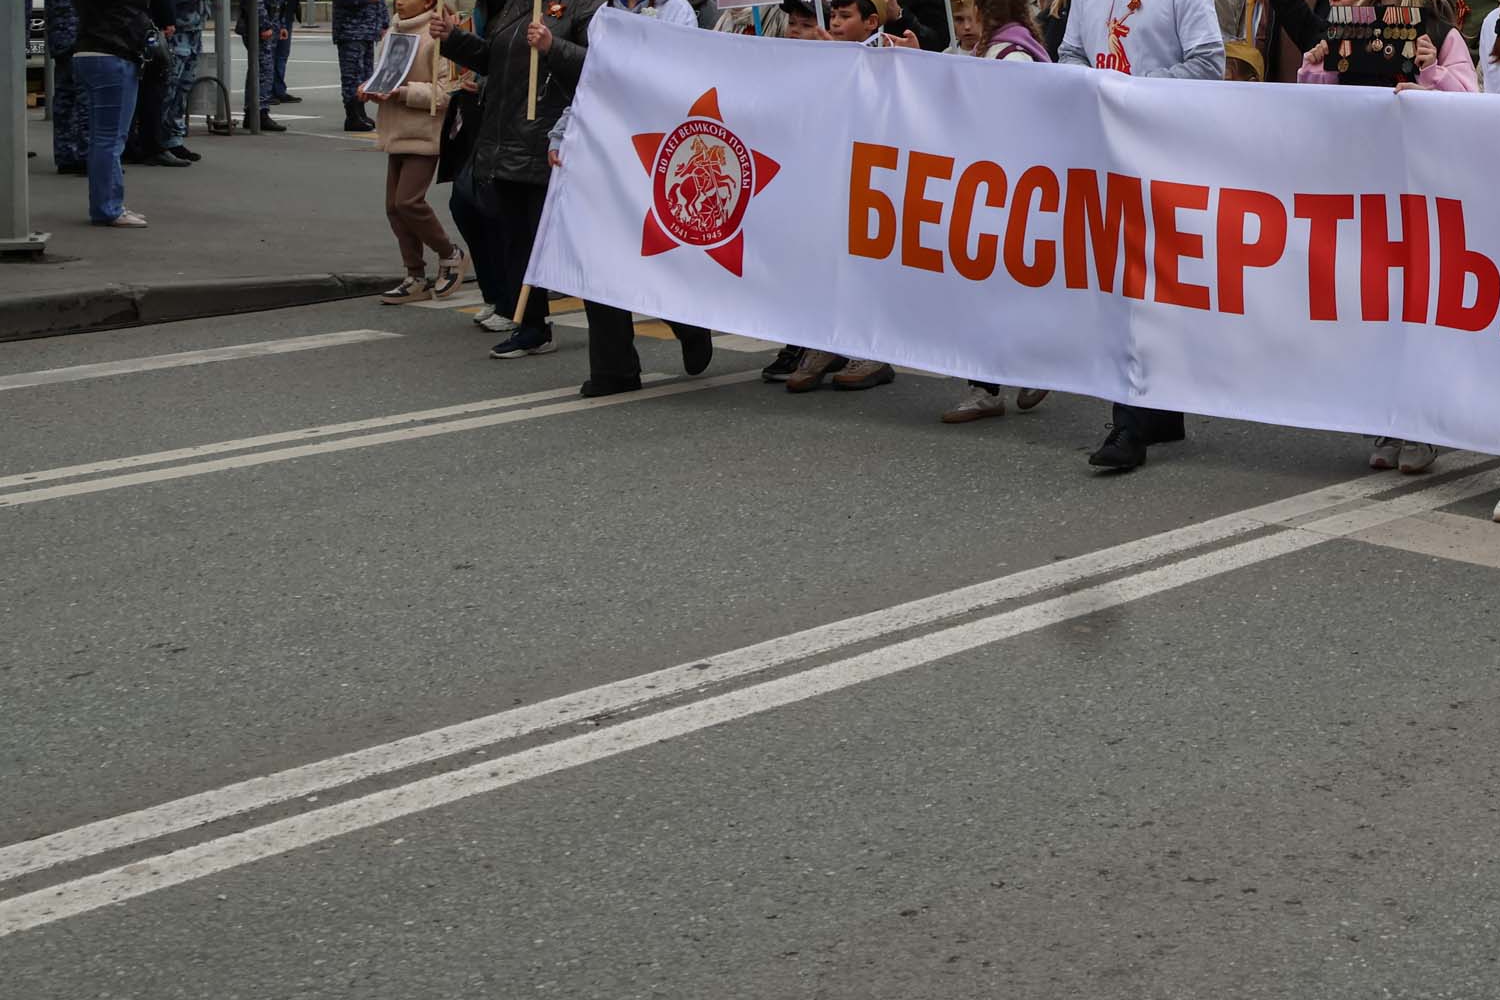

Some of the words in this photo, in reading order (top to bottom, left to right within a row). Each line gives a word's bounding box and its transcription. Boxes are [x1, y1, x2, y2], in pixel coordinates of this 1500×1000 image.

[1095, 53, 1117, 70] 80
[664, 135, 679, 157] ЛЕТ
[678, 122, 727, 140] ВЕЛИКОЙ
[728, 136, 751, 190] ПОБЕДЫ
[670, 222, 688, 239] 1941
[702, 229, 722, 241] 1945
